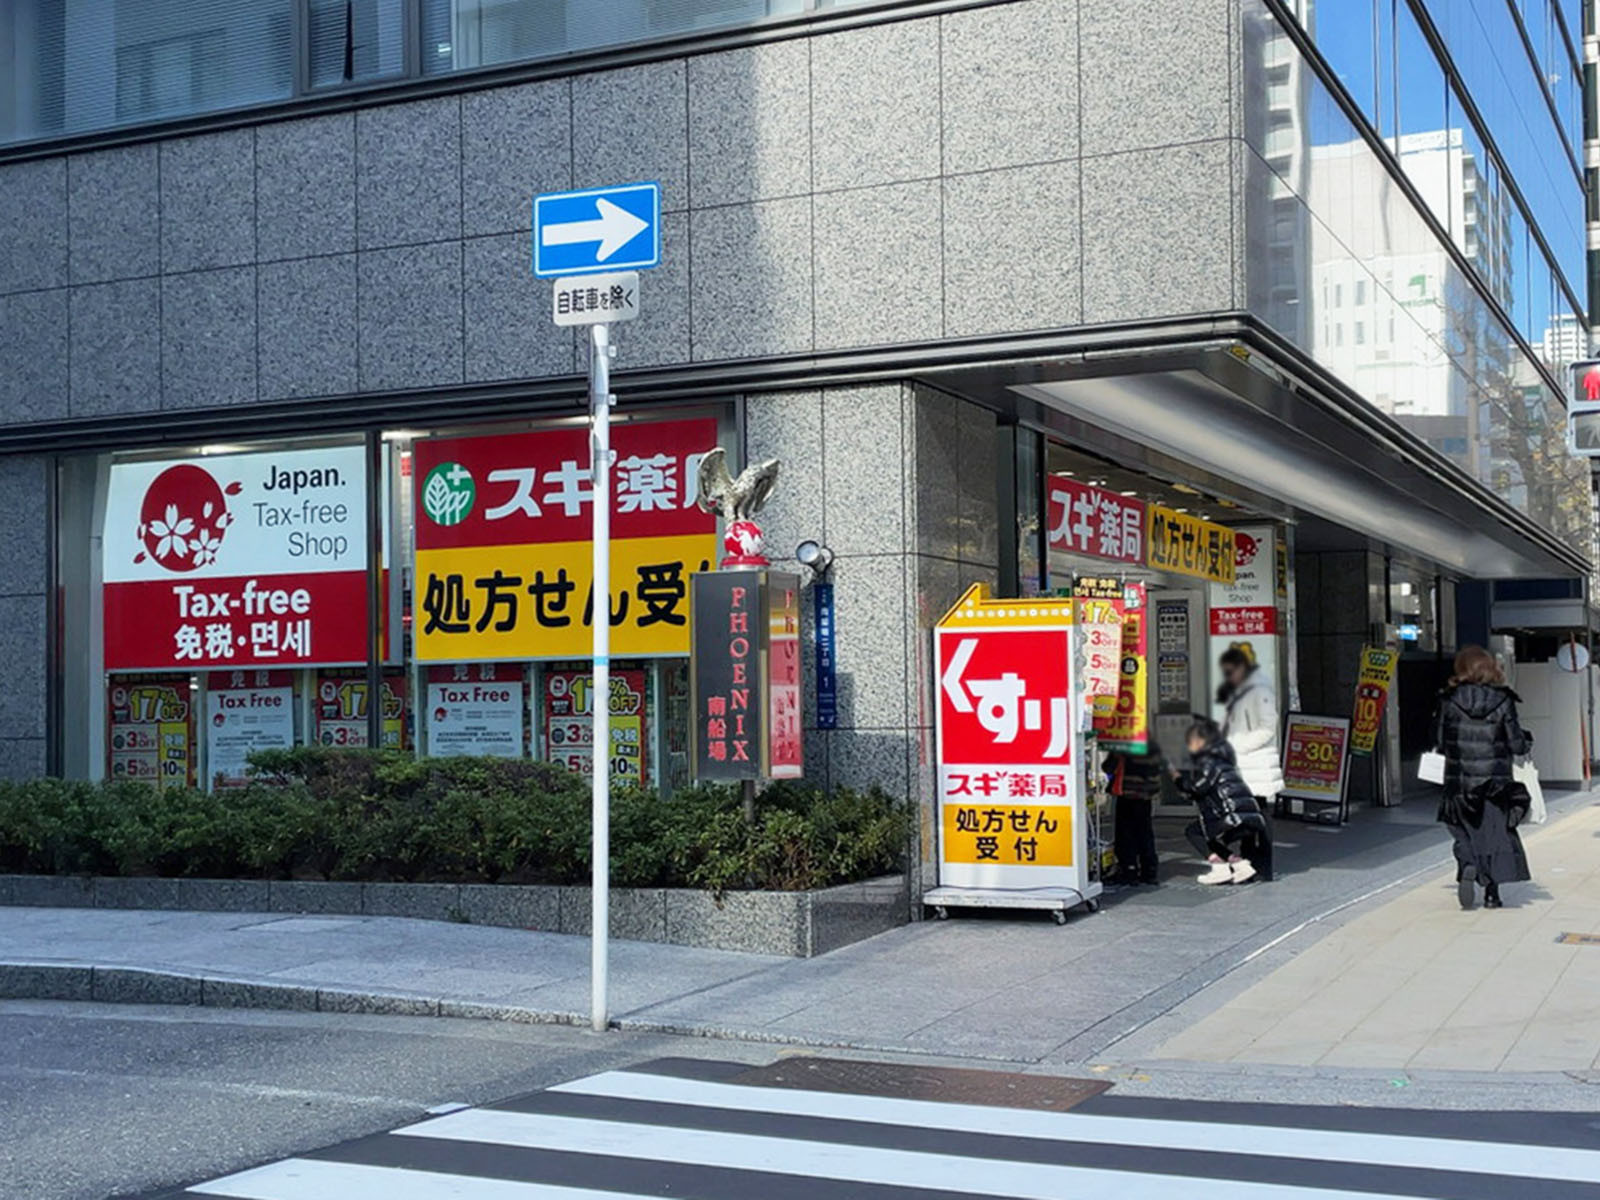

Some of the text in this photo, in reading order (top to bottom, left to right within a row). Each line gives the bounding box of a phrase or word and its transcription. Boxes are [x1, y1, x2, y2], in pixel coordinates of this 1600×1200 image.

[558, 285, 634, 314] 自転車を除く
[263, 465, 346, 495] Japan.
[253, 500, 347, 527] Tax-free
[1050, 489, 1141, 561] スギ薬局
[288, 532, 347, 560] Shop
[1152, 511, 1233, 579] 処方せん受付
[173, 580, 311, 618] Tax-free
[424, 560, 709, 634] 処方せん受
[1217, 609, 1264, 620] Tax-free
[729, 587, 750, 762] PHOENIX
[218, 693, 282, 709] Tax Free
[439, 687, 510, 702] Tax Free
[609, 697, 638, 712] OFF
[941, 638, 1068, 759] くすり
[946, 771, 1067, 797] スギ薬局
[956, 808, 1057, 833] 処方せん
[976, 836, 1038, 861] 受付
